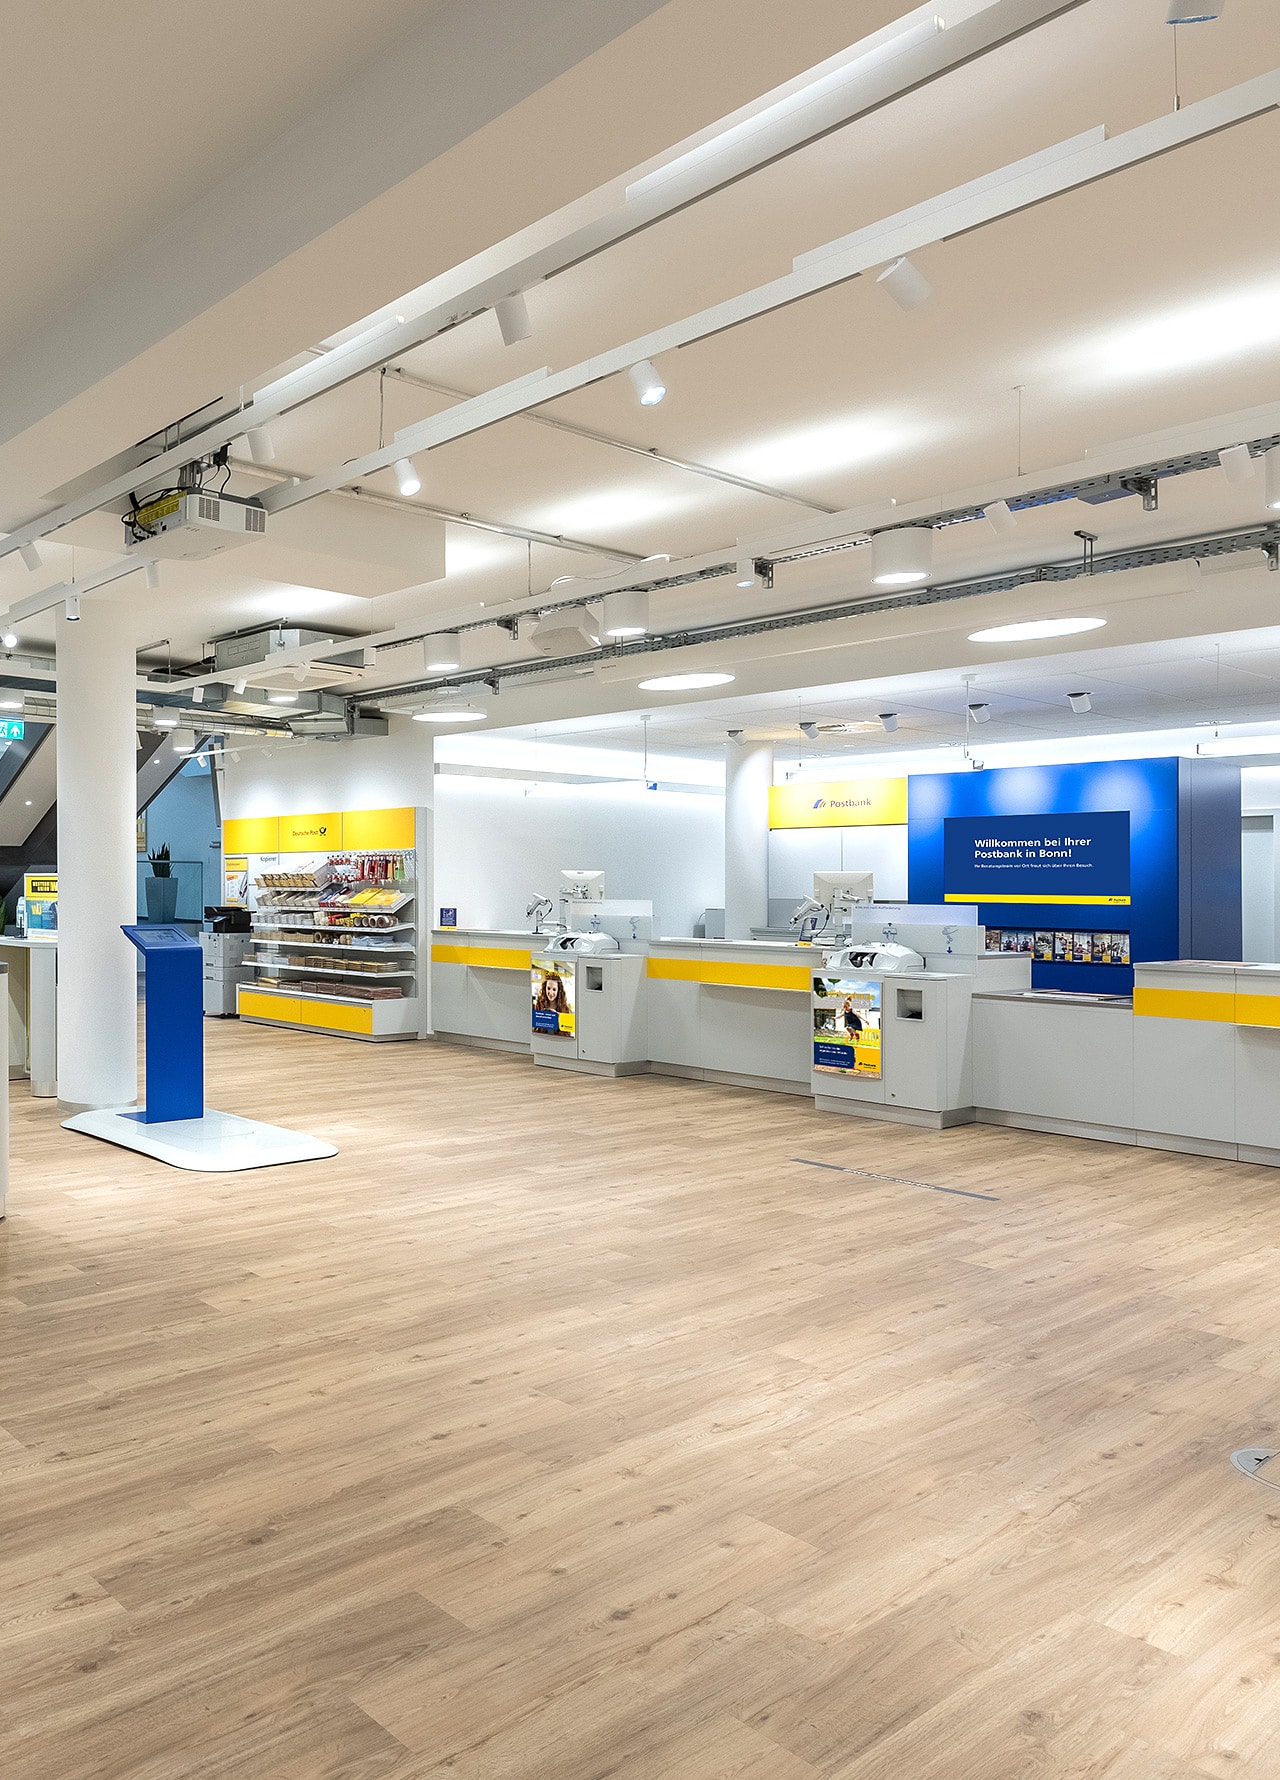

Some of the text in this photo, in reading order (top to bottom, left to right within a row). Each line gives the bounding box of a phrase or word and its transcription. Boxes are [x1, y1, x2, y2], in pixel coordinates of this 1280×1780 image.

[830, 797, 872, 808] Postbank
[974, 837, 1091, 848] Willkommen bei Ihrer
[974, 848, 1072, 859] Postbank in Bonn!
